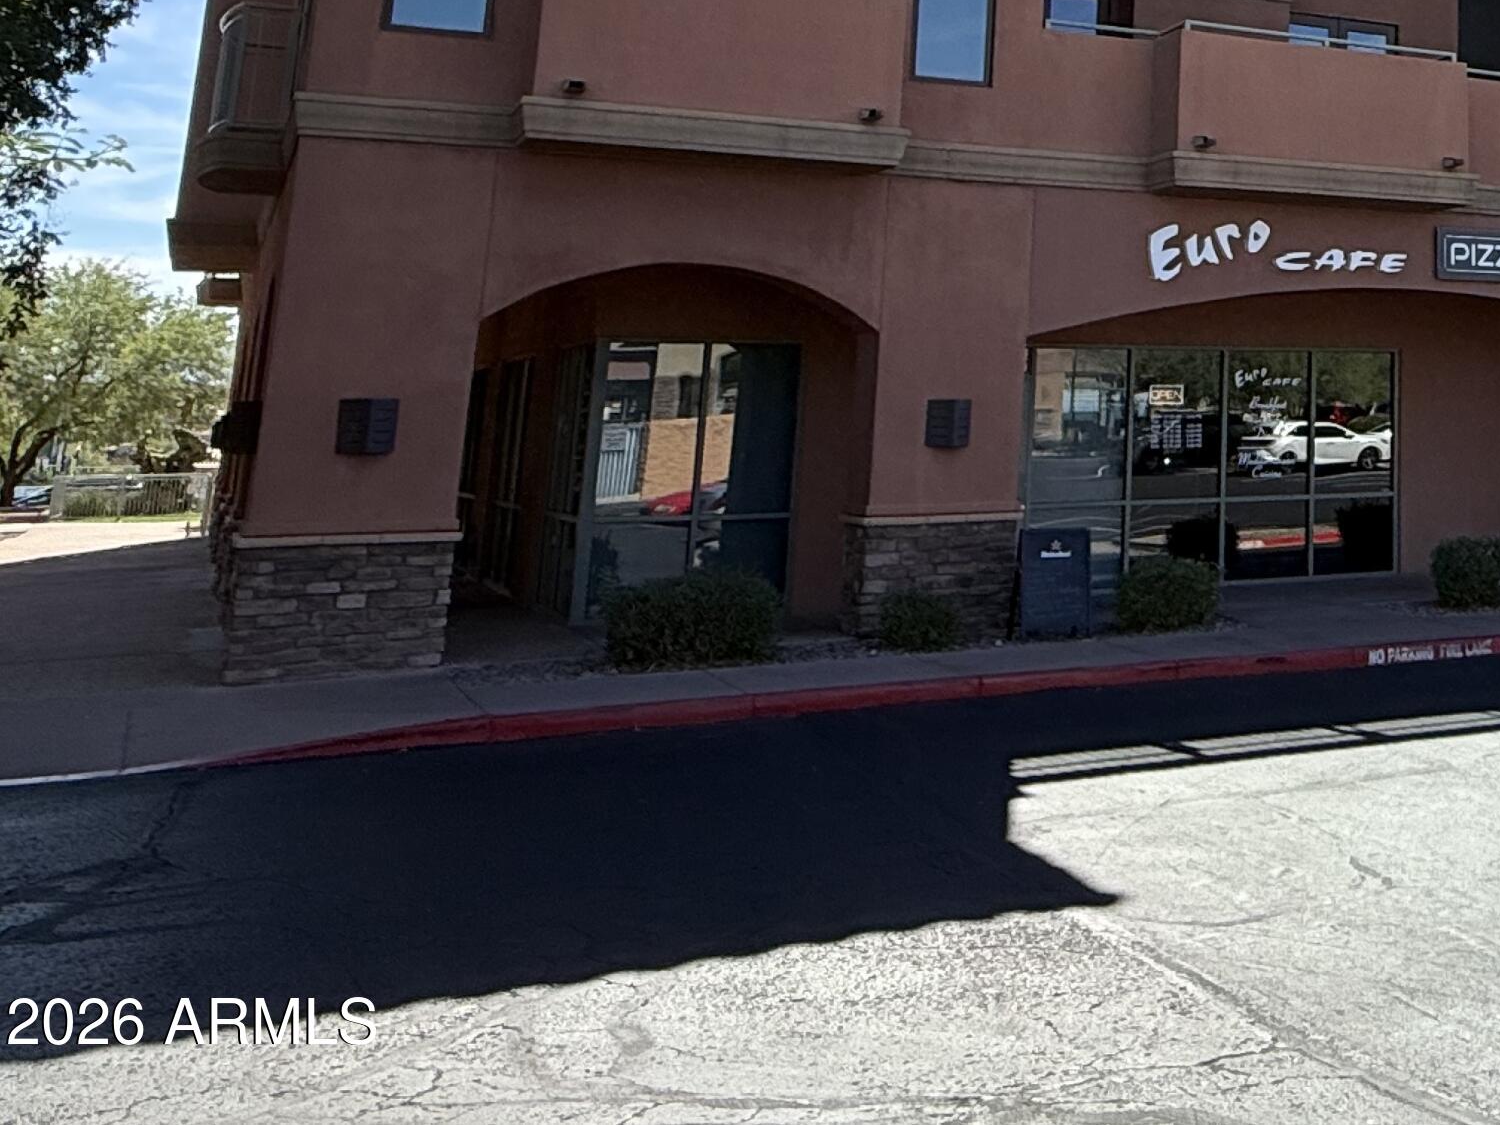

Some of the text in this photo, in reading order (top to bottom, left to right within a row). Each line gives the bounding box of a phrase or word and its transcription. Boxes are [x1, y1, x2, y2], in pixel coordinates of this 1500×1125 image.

[1147, 220, 1408, 282] Euro CAFE
[1151, 389, 1183, 402] OPEN
[1368, 647, 1385, 666] NO
